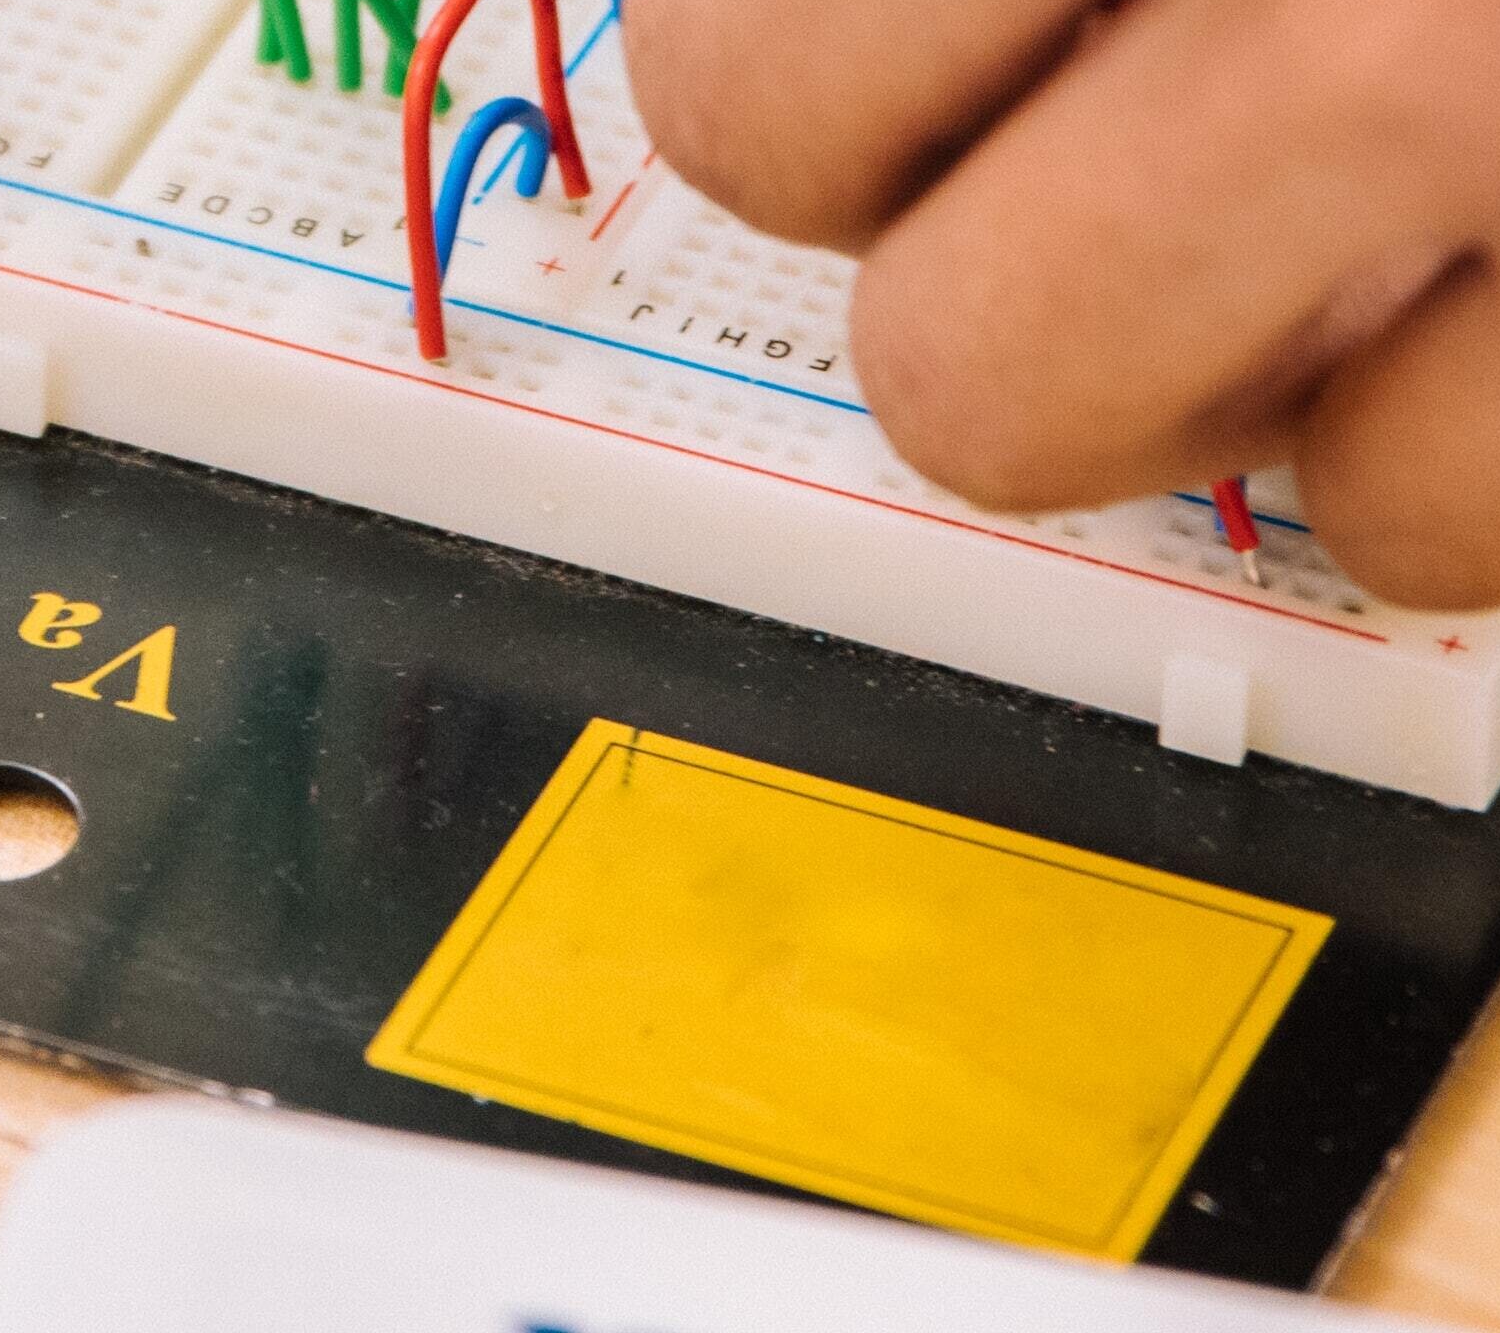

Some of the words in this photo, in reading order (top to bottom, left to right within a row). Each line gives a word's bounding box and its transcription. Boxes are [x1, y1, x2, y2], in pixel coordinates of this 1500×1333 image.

[629, 303, 655, 320] J
[679, 316, 695, 333] I
[716, 326, 748, 348] H
[763, 338, 793, 359] G
[808, 355, 838, 372] F
[18, 591, 177, 721] Va
